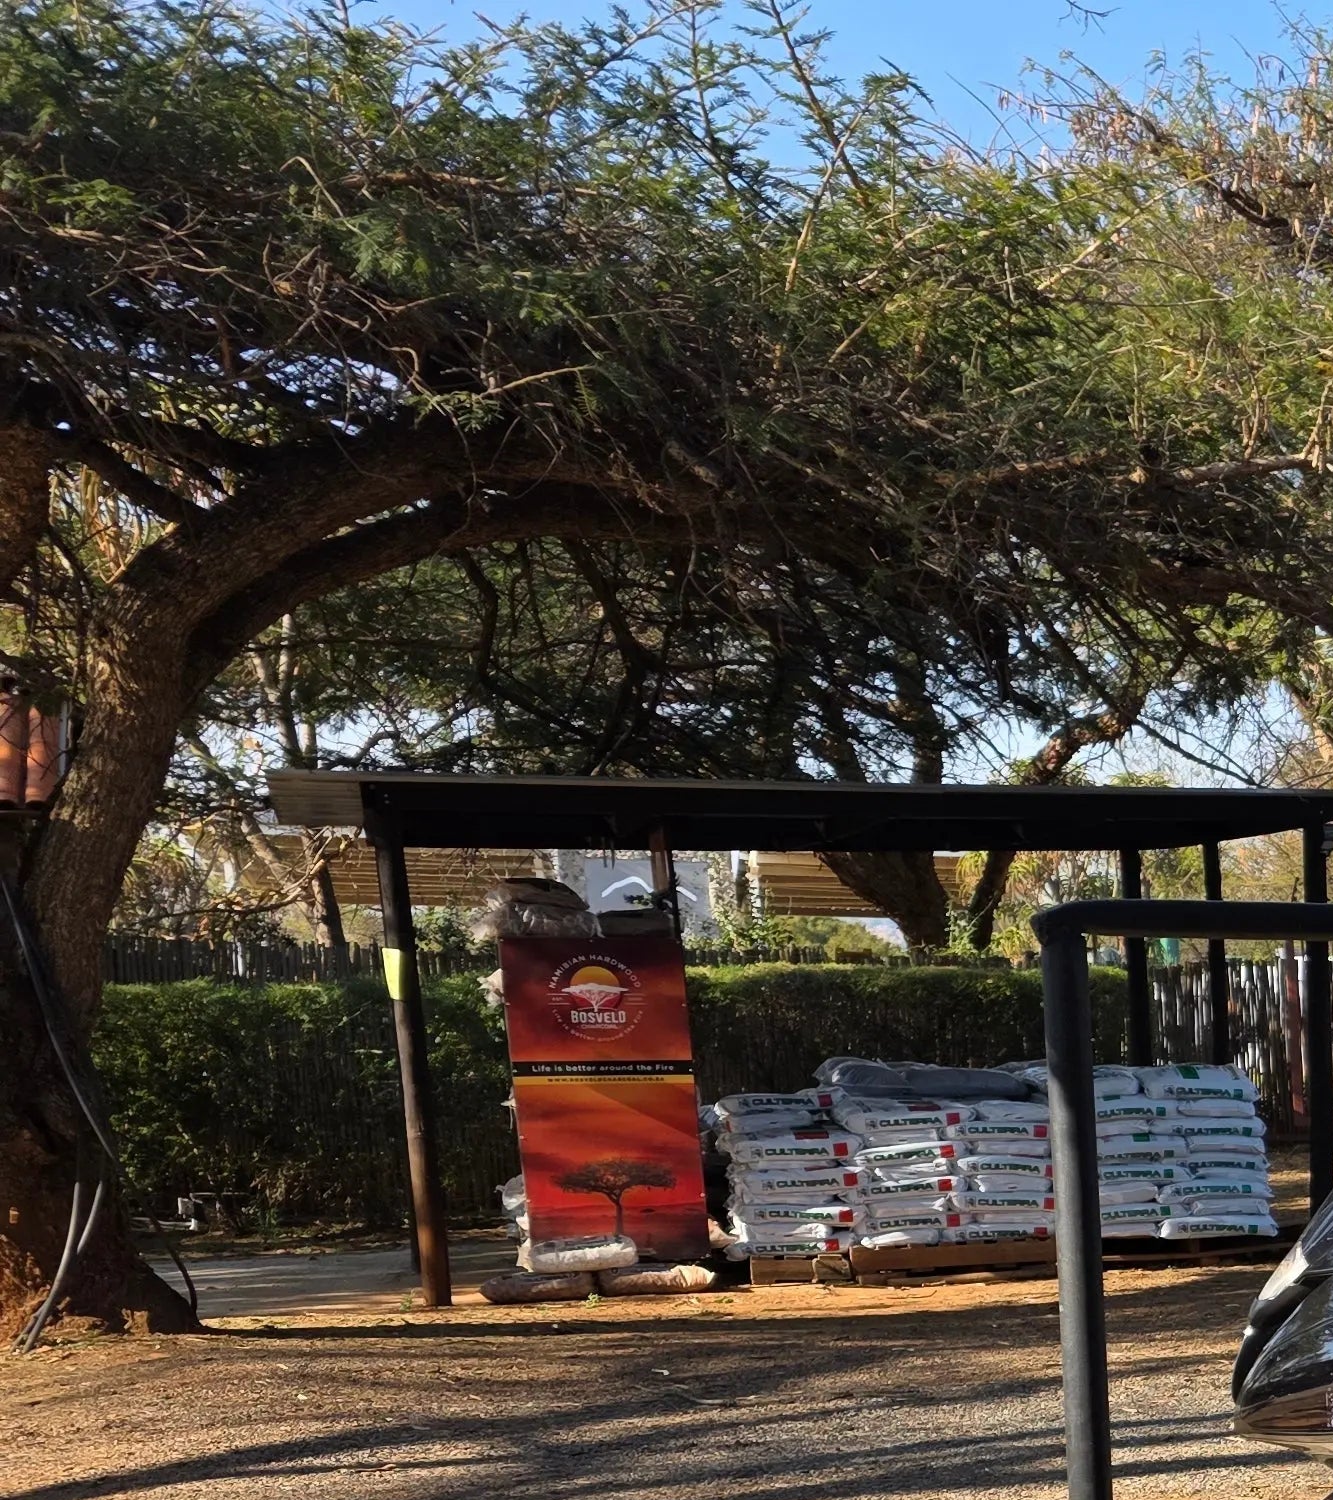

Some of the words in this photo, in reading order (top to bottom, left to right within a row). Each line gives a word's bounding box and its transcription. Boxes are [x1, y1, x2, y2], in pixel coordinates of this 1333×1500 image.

[548, 955, 586, 989] NAMIBIAN
[589, 954, 641, 988] HARDWOOD
[570, 1010, 627, 1024] BOSVELD
[531, 1065, 551, 1073] Life
[554, 1064, 563, 1072] is
[565, 1064, 597, 1072] better
[655, 1063, 675, 1071] Fire
[1176, 1087, 1232, 1096] CULTERRA
[752, 1097, 816, 1106] CULTERRA
[880, 1116, 943, 1127] CULTERRA
[968, 1126, 1030, 1135] CULTERRA
[1184, 1127, 1240, 1135] CULTERRA
[765, 1147, 830, 1156] CULTERRA
[874, 1149, 937, 1161] CULTERRA
[980, 1163, 1041, 1173] CULTERRA
[1103, 1170, 1162, 1179] CULTERRA
[776, 1178, 840, 1188] CULTERRA
[871, 1182, 934, 1195] CULTERRA
[1182, 1185, 1239, 1194] CULTERRA
[978, 1198, 1039, 1207] CULTERRA
[768, 1211, 834, 1221] CULTERRA
[1101, 1208, 1159, 1221] CULTERRA
[880, 1216, 943, 1229] CULTERRA
[1189, 1224, 1246, 1233] CULTERRA
